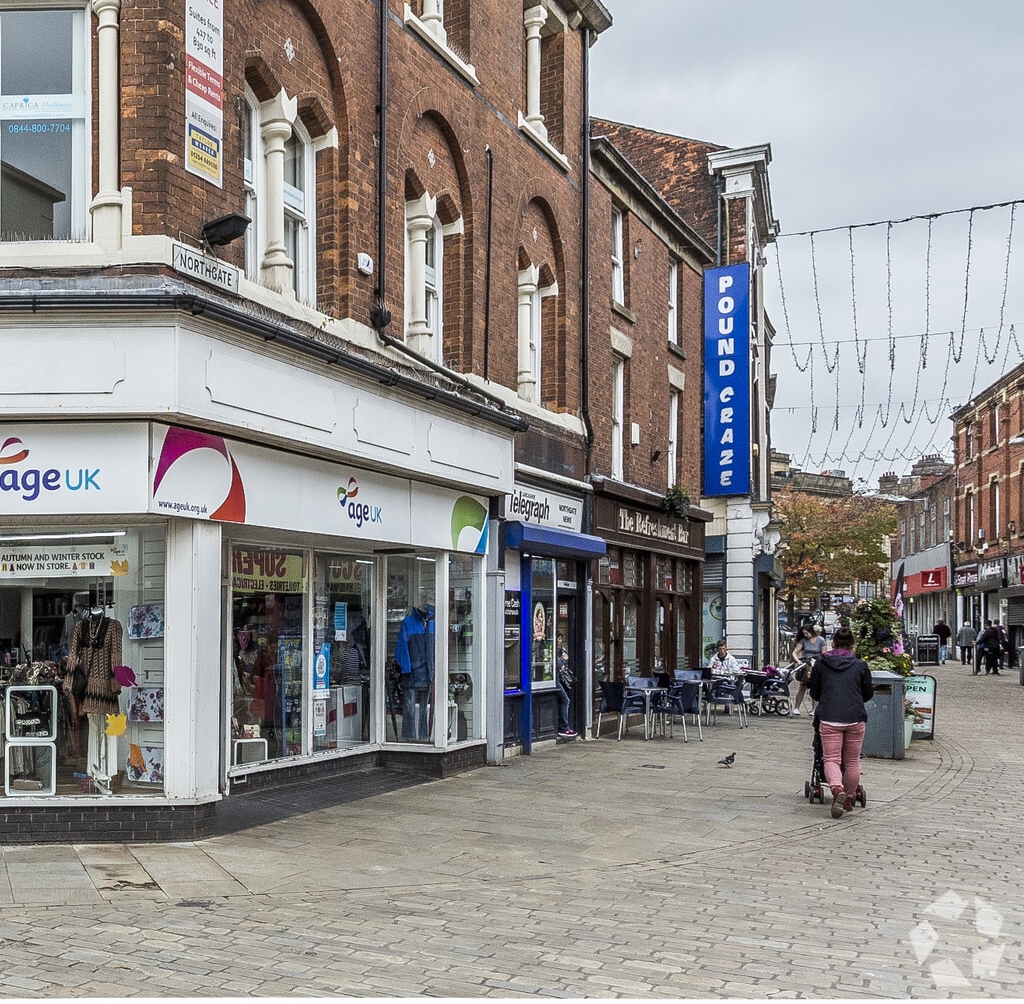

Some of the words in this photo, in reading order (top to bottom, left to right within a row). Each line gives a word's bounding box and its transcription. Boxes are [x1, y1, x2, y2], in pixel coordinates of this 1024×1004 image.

[188, 6, 206, 27] Suites
[205, 18, 221, 37] from
[192, 36, 204, 52] 830
[207, 33, 214, 44] to
[187, 74, 193, 84] &
[192, 77, 207, 95] Cheap
[207, 87, 221, 102] Rents
[188, 60, 207, 79] Flexible
[206, 72, 221, 88] Terms
[8, 123, 71, 134] 0844-800-7704
[179, 252, 233, 287] NORTHGATE
[717, 275, 735, 377] POUND
[719, 386, 734, 487] CRAZE
[0, 468, 61, 502] age
[65, 468, 102, 491] UK
[157, 500, 208, 515] www.ageuk.org.uk
[348, 501, 370, 528] age
[370, 506, 382, 524] UK
[510, 489, 550, 525] Telegraph
[619, 508, 634, 532] The
[635, 511, 677, 541] Refreshment
[677, 523, 689, 544] Bar
[1, 553, 33, 562] AUTUMN
[33, 553, 51, 562] AND
[51, 552, 81, 561] WINTER
[81, 552, 105, 561] STOCK
[16, 563, 36, 571] NOW
[36, 562, 45, 571] IN
[46, 562, 72, 571] STORE.
